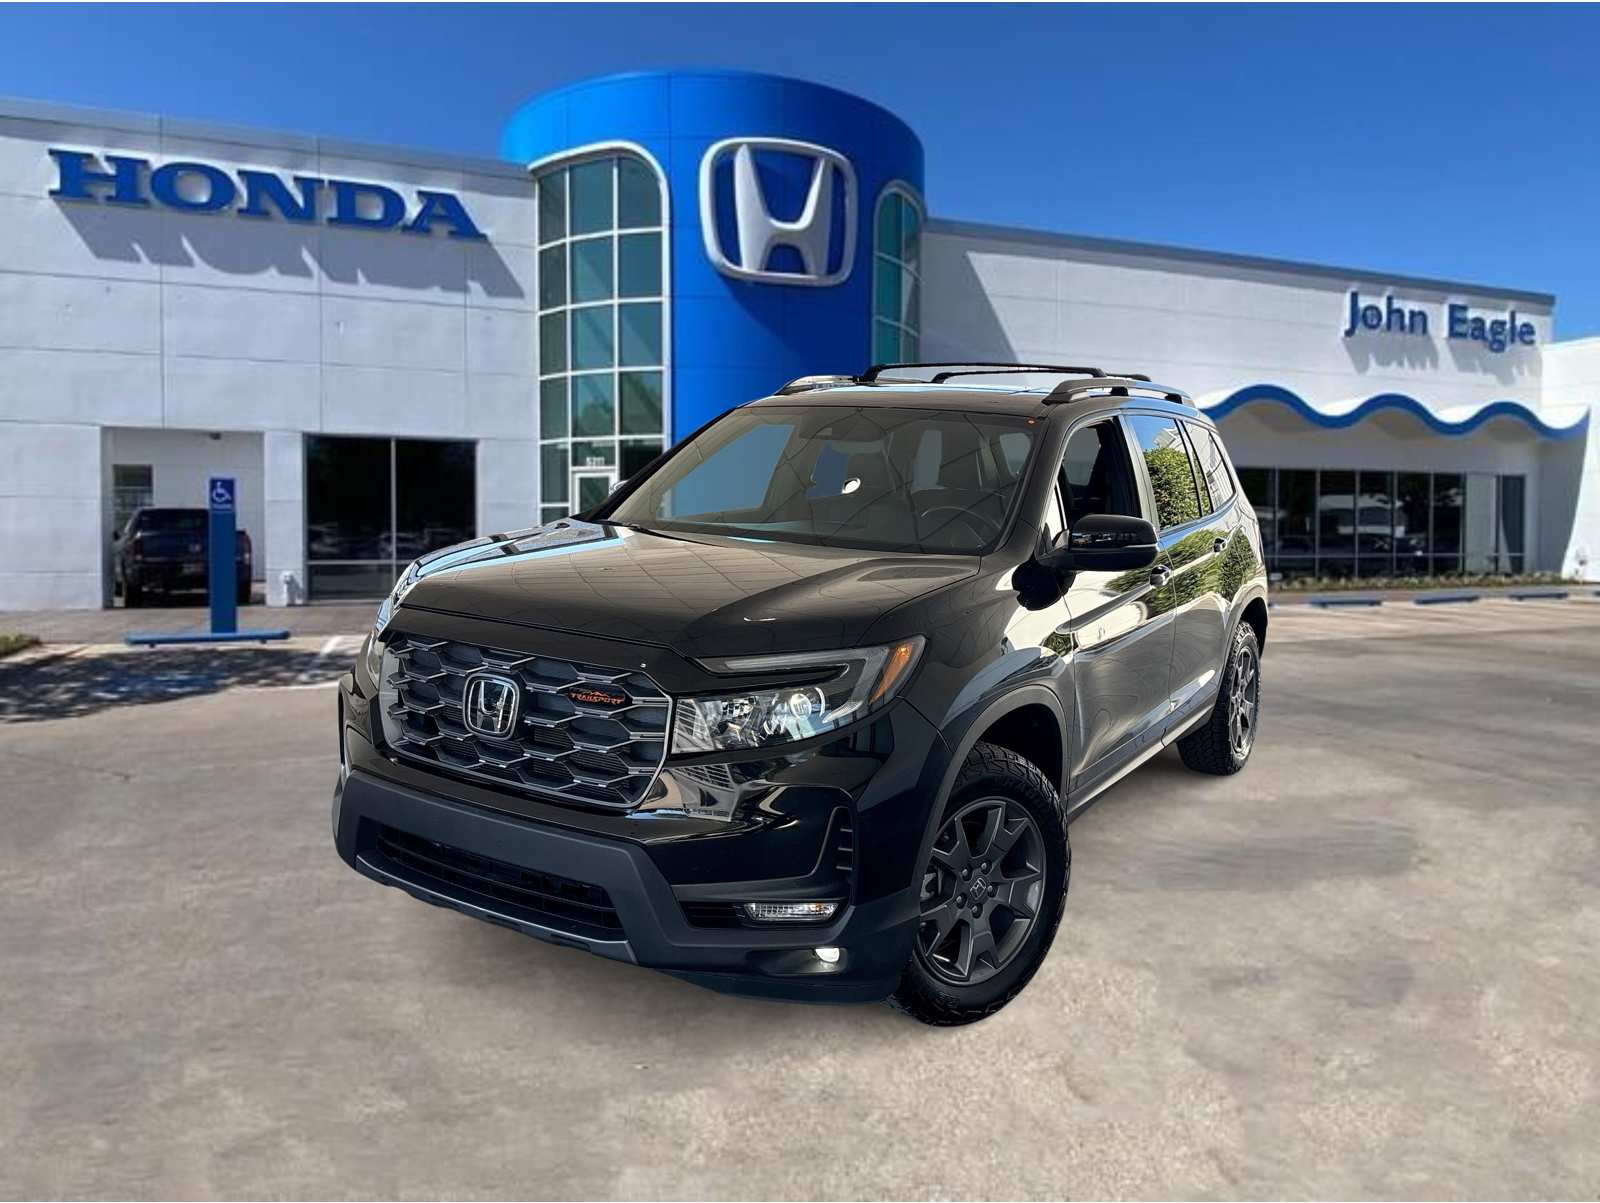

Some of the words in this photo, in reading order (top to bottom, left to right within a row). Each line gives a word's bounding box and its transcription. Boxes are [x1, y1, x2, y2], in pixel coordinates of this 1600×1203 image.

[48, 148, 488, 240] HONDA
[1344, 290, 1428, 338] John
[1448, 303, 1536, 353] Eagle
